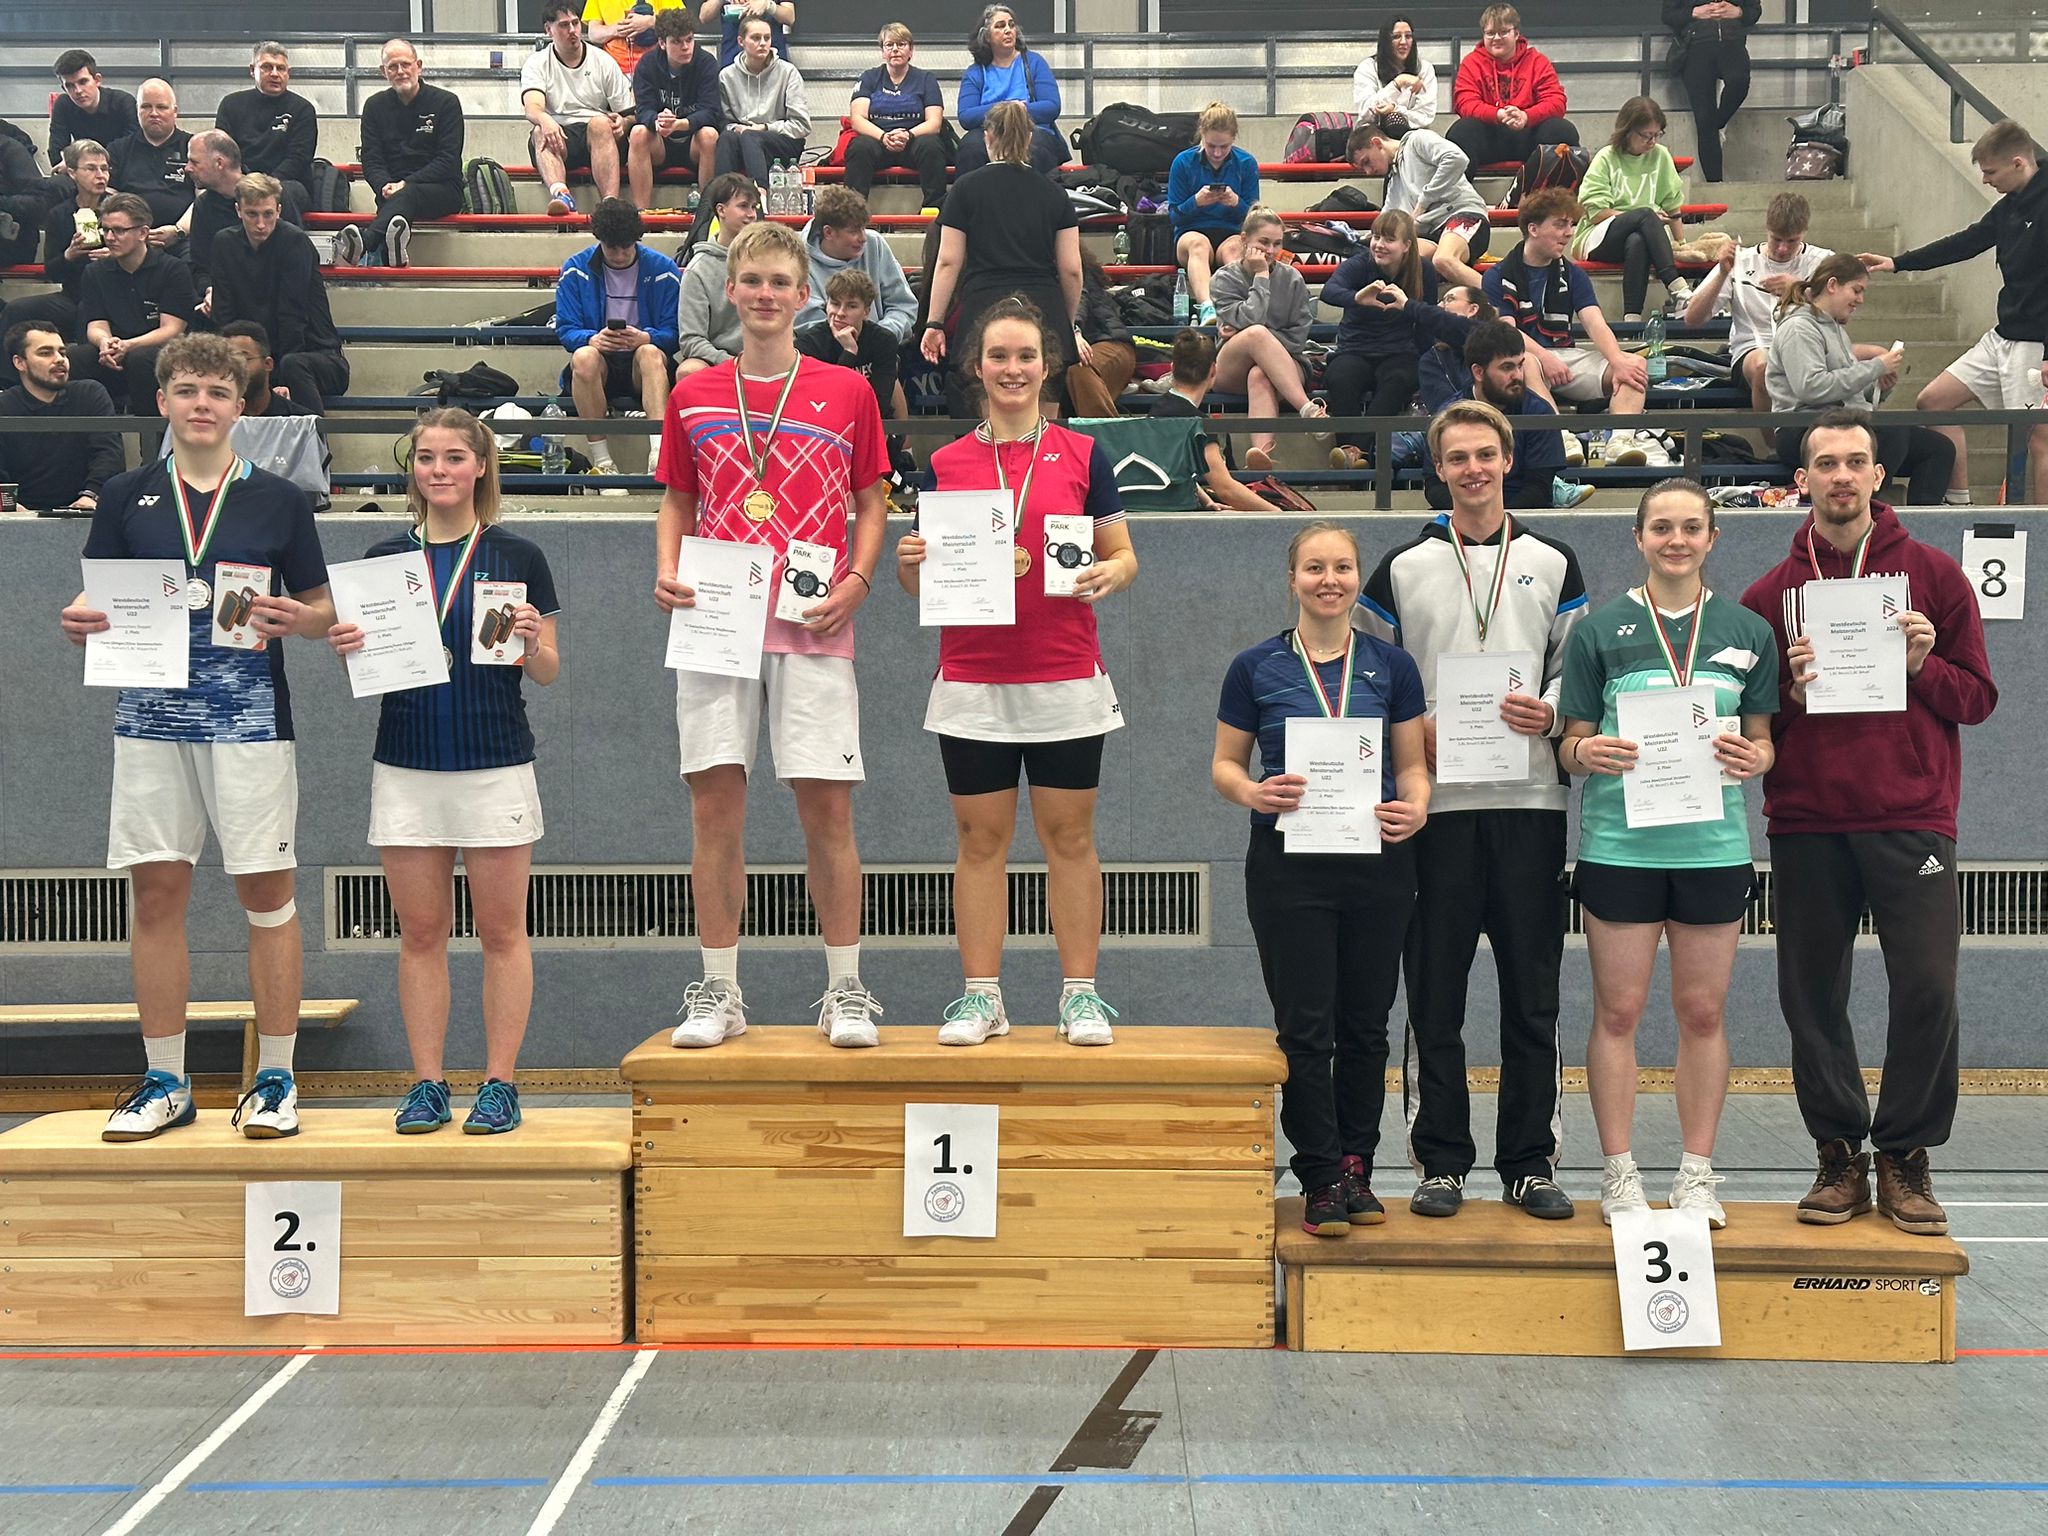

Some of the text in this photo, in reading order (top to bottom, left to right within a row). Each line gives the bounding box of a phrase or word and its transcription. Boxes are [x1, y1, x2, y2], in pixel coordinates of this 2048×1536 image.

[793, 549, 812, 558] PARK
[474, 572, 489, 581] FZ
[1981, 559, 2007, 598] 8
[1918, 865, 1945, 876] adidas
[933, 1133, 973, 1175] 1.
[273, 1211, 317, 1252] 2.
[1643, 1240, 1689, 1284] 3.
[1793, 1278, 1871, 1290] ERHARD
[1875, 1279, 1916, 1291] SPORT
